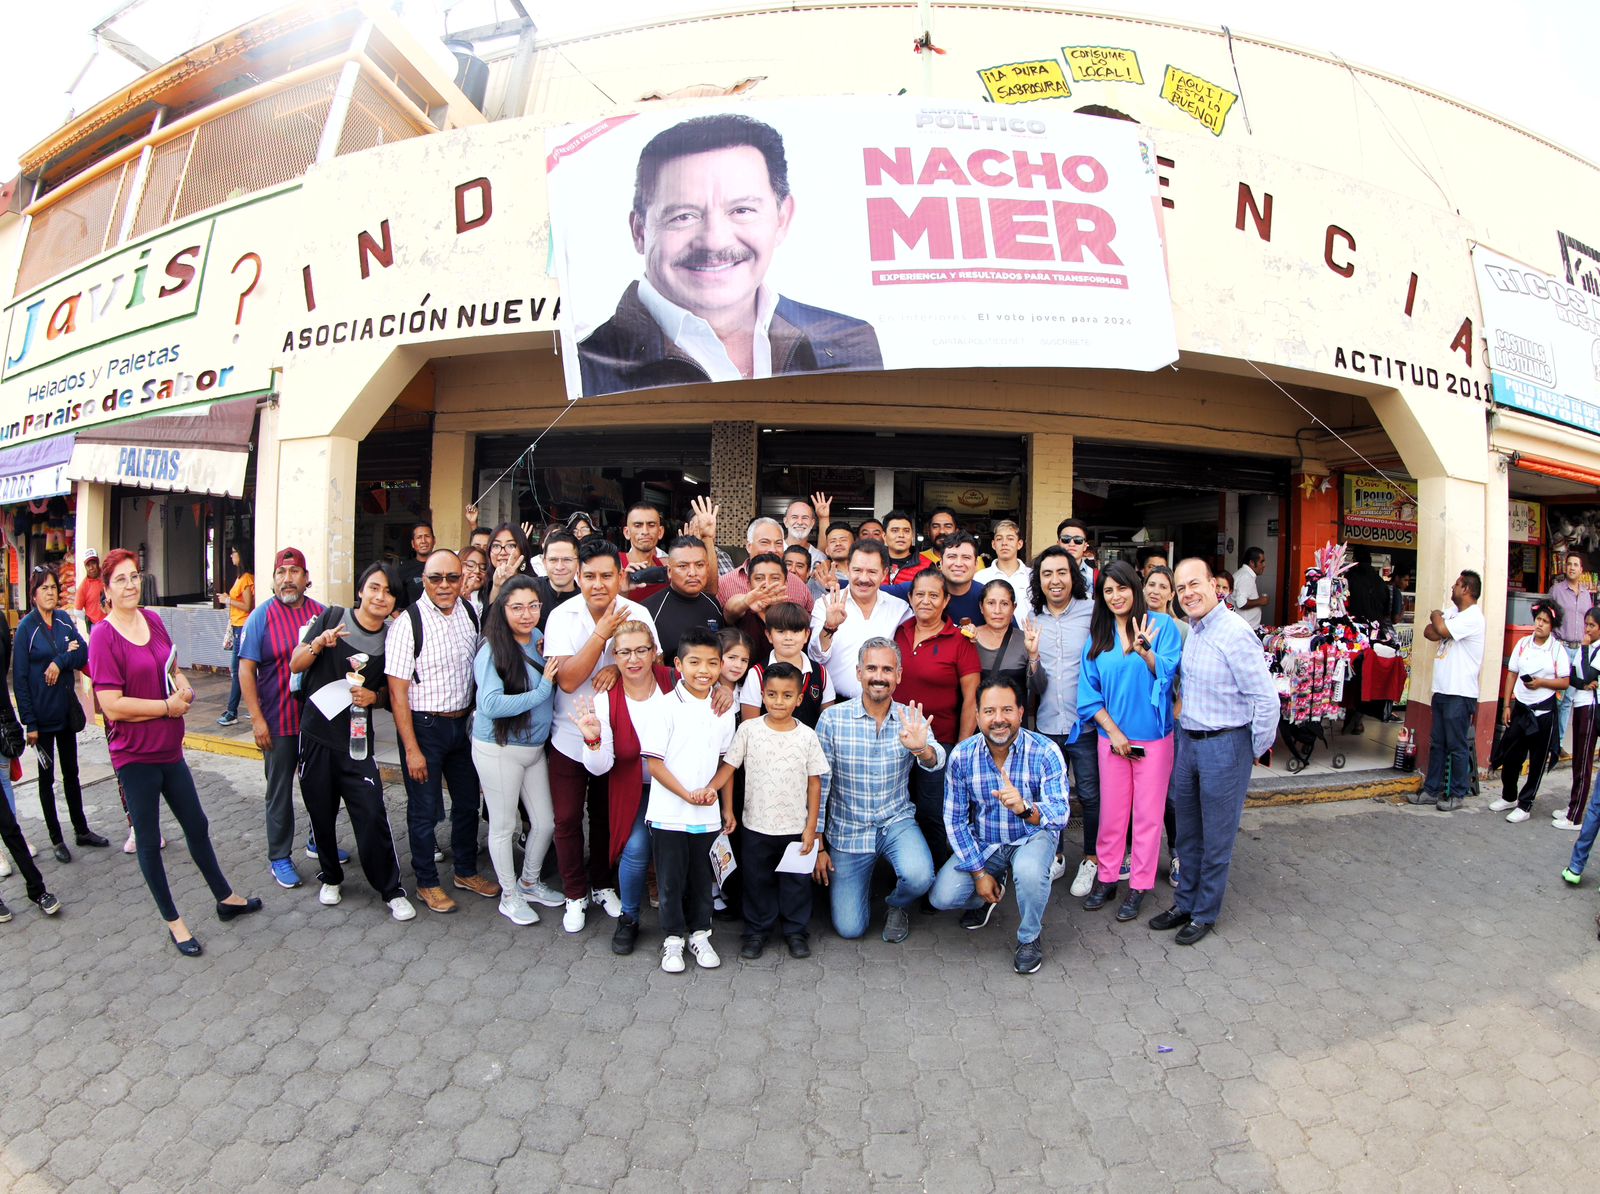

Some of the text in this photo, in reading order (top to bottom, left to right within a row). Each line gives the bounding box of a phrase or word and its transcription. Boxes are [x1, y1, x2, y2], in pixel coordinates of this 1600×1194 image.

[1071, 49, 1126, 62] CONSUME
[1091, 59, 1107, 67] LO
[1176, 84, 1205, 103] ESTA
[863, 147, 1108, 193] NACHO
[866, 197, 1125, 266] MIER
[879, 271, 1122, 286] EXPERIENCIA Y RESULTADOS PARA TRANSFORMAR
[1485, 263, 1589, 315] RICOS
[7, 245, 201, 369] Javis
[977, 312, 990, 321] El
[996, 313, 1025, 322] voto
[1031, 313, 1066, 324] joven
[1071, 315, 1099, 325] para
[1104, 316, 1133, 326] 2024
[282, 293, 447, 352] ASOCIACIÓN
[1335, 346, 1439, 390] ACTITUD
[1445, 373, 1493, 404] 2011
[1495, 328, 1547, 364] COSTILLAS
[28, 343, 181, 404] Helados y Paletas
[1494, 346, 1552, 384] ROSTIZADAS
[102, 387, 134, 412] de
[140, 365, 235, 404] Sabor
[1505, 376, 1535, 398] POLLO
[1536, 388, 1570, 410] FRESCO
[117, 447, 181, 481] PALETAS
[1363, 490, 1395, 502] POLLO
[1345, 525, 1413, 544] ADOBADOS
